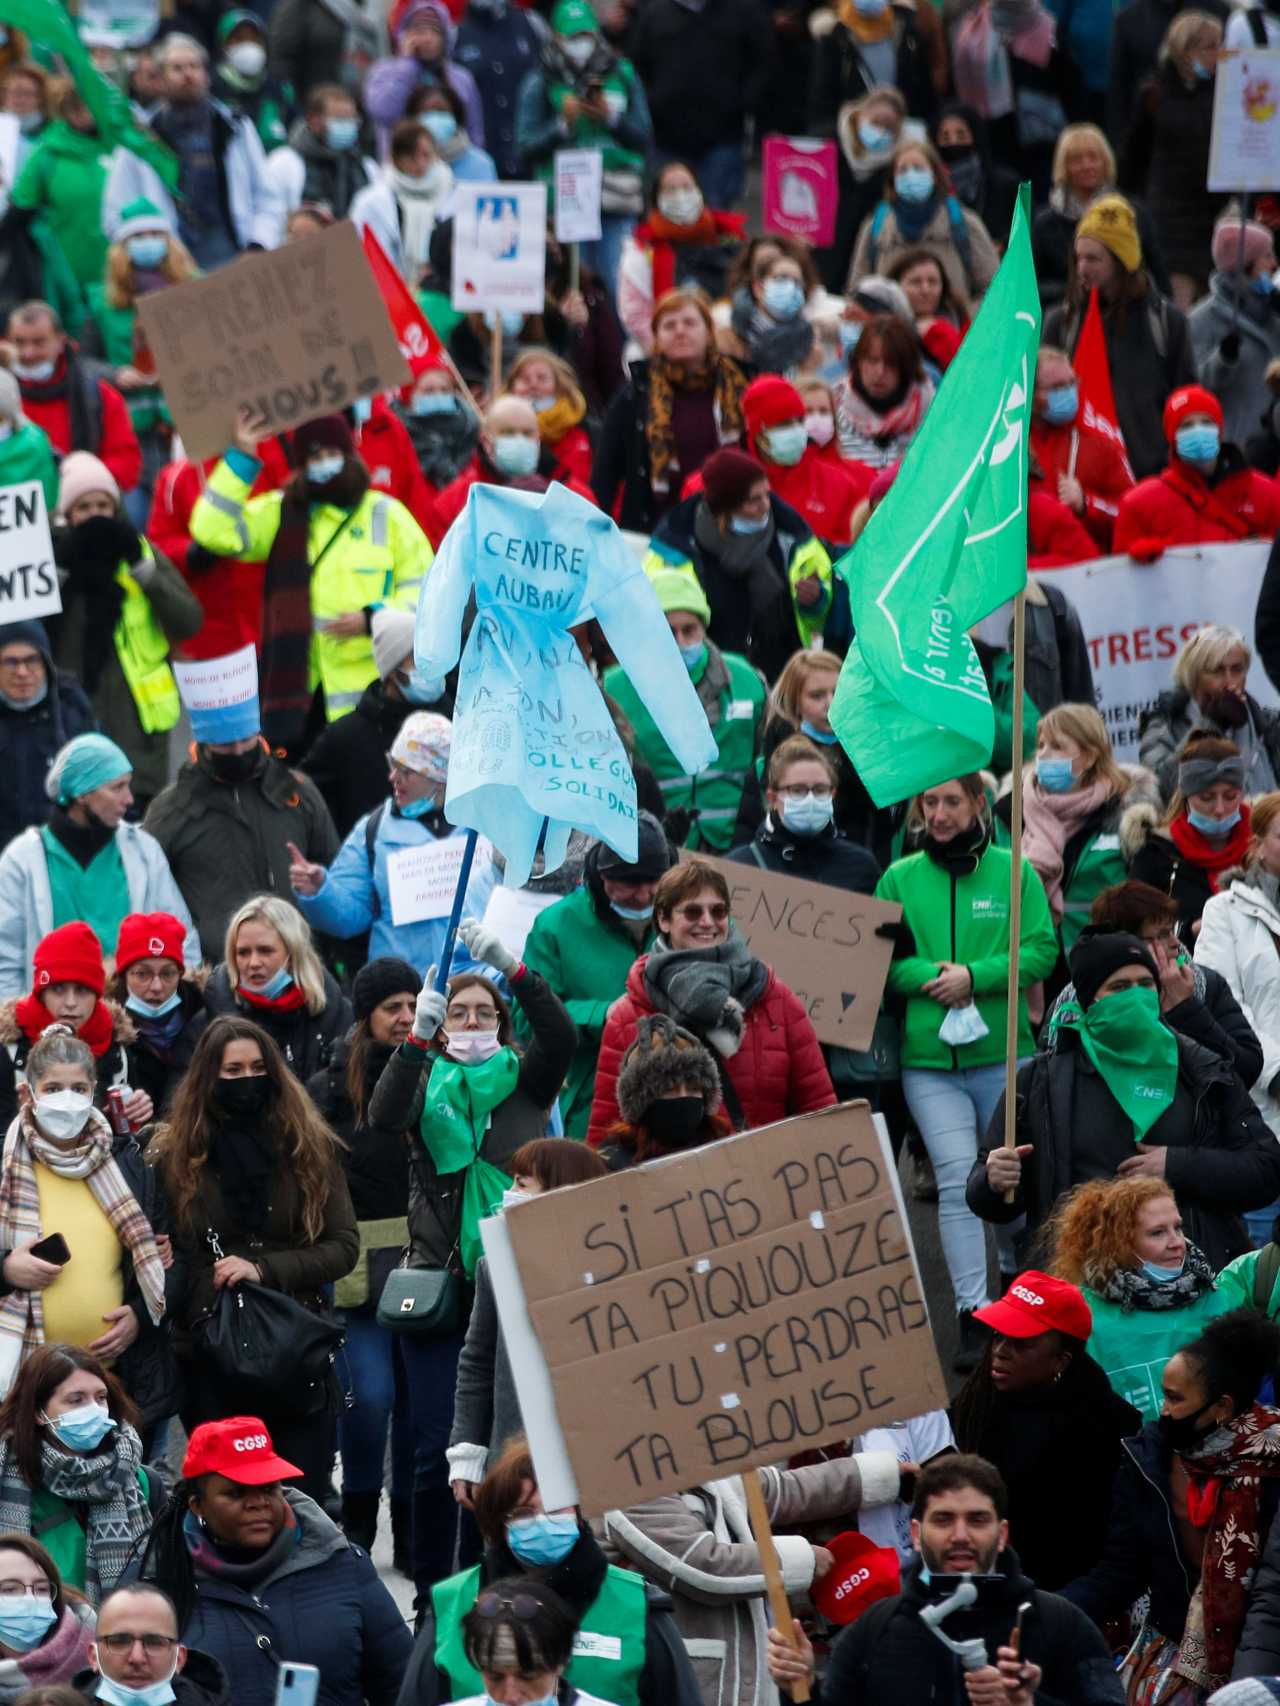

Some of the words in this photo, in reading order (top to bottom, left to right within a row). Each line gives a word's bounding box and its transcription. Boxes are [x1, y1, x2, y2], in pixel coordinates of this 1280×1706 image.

[484, 531, 585, 576] CENTRE
[730, 884, 867, 947] ENCES
[1135, 1085, 1163, 1099] CNE
[654, 1179, 761, 1256] T'AS
[772, 1144, 880, 1220] PAS
[1011, 1284, 1045, 1306] CGSP
[570, 1301, 640, 1354] TA
[632, 1355, 705, 1410] TU
[733, 1275, 929, 1388] PERDRAS
[233, 1434, 268, 1452] CGSP
[613, 1432, 680, 1487] TA
[696, 1364, 895, 1467] BLOUSE
[835, 1568, 870, 1600] CGSP
